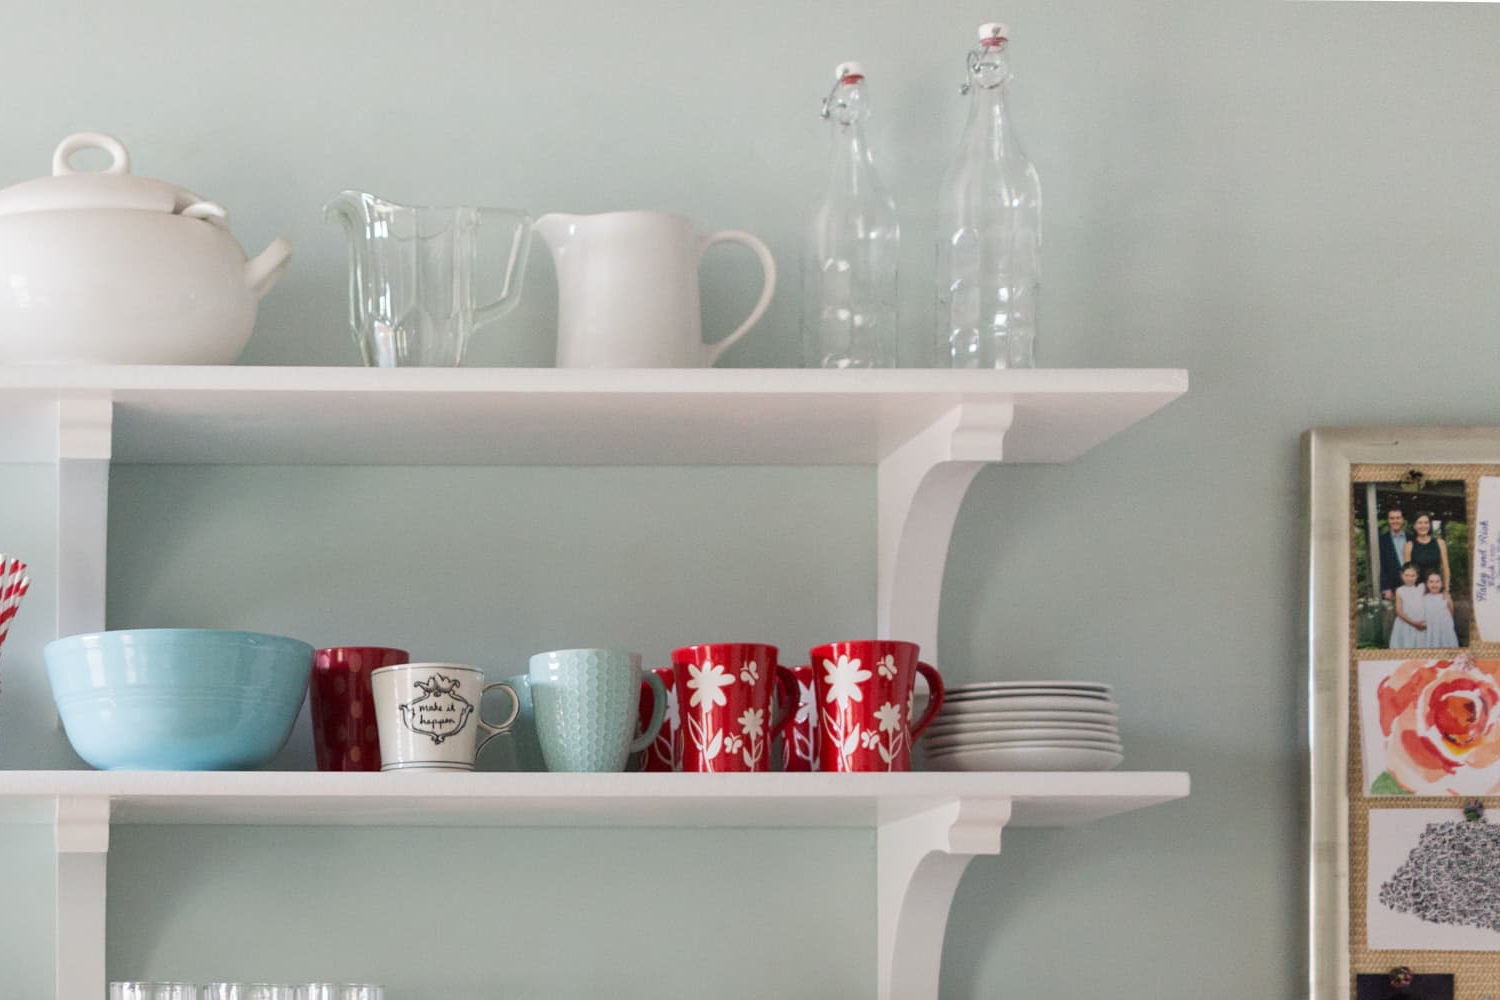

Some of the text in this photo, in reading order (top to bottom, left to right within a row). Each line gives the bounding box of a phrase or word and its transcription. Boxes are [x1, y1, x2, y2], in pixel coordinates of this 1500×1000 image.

[419, 702, 456, 712] make it
[419, 715, 455, 729] happen
